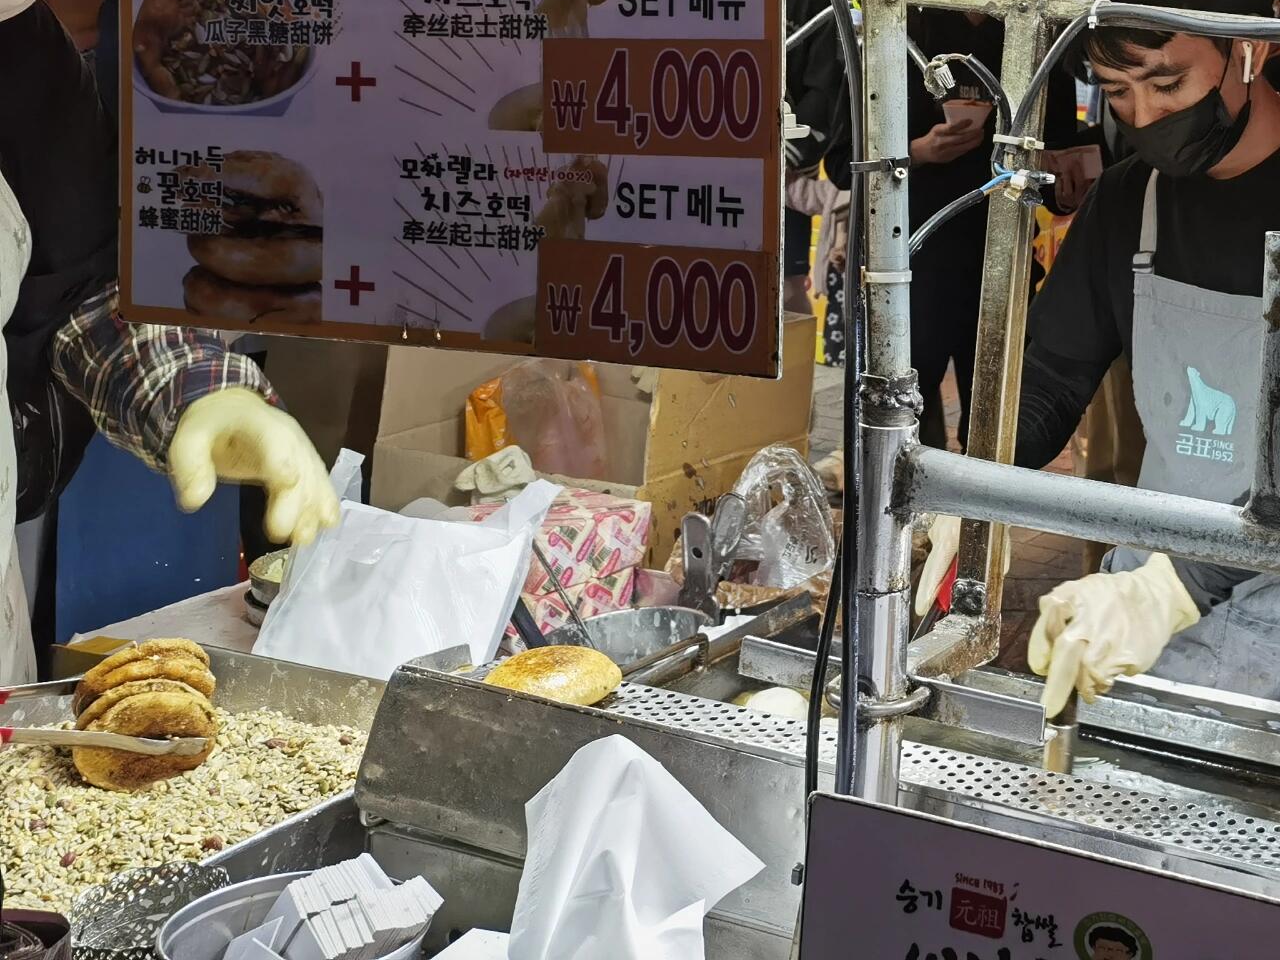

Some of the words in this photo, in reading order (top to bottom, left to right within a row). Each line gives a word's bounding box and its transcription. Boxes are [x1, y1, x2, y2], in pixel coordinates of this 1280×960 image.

[204, 18, 334, 47] 瓜子黑糖甜饼
[403, 12, 548, 41] 牵丝起士甜饼
[134, 145, 225, 173] 허니가득
[156, 171, 223, 207] 꿀호떡
[502, 167, 594, 185] (자연산100%)
[419, 186, 532, 223] 치즈호떡
[615, 180, 680, 222] SET
[686, 182, 745, 229] 메뉴
[137, 206, 223, 234] 蜂蜜甜饼
[402, 220, 546, 252] 牵丝起士甜饼
[1175, 433, 1213, 459] 곰표
[1211, 450, 1234, 463] 1952
[1212, 440, 1235, 452] SINCE
[983, 878, 1005, 895] 1983
[895, 878, 943, 914] 승기
[954, 898, 1001, 931] 元祖
[1011, 907, 1064, 949] 찹쌀
